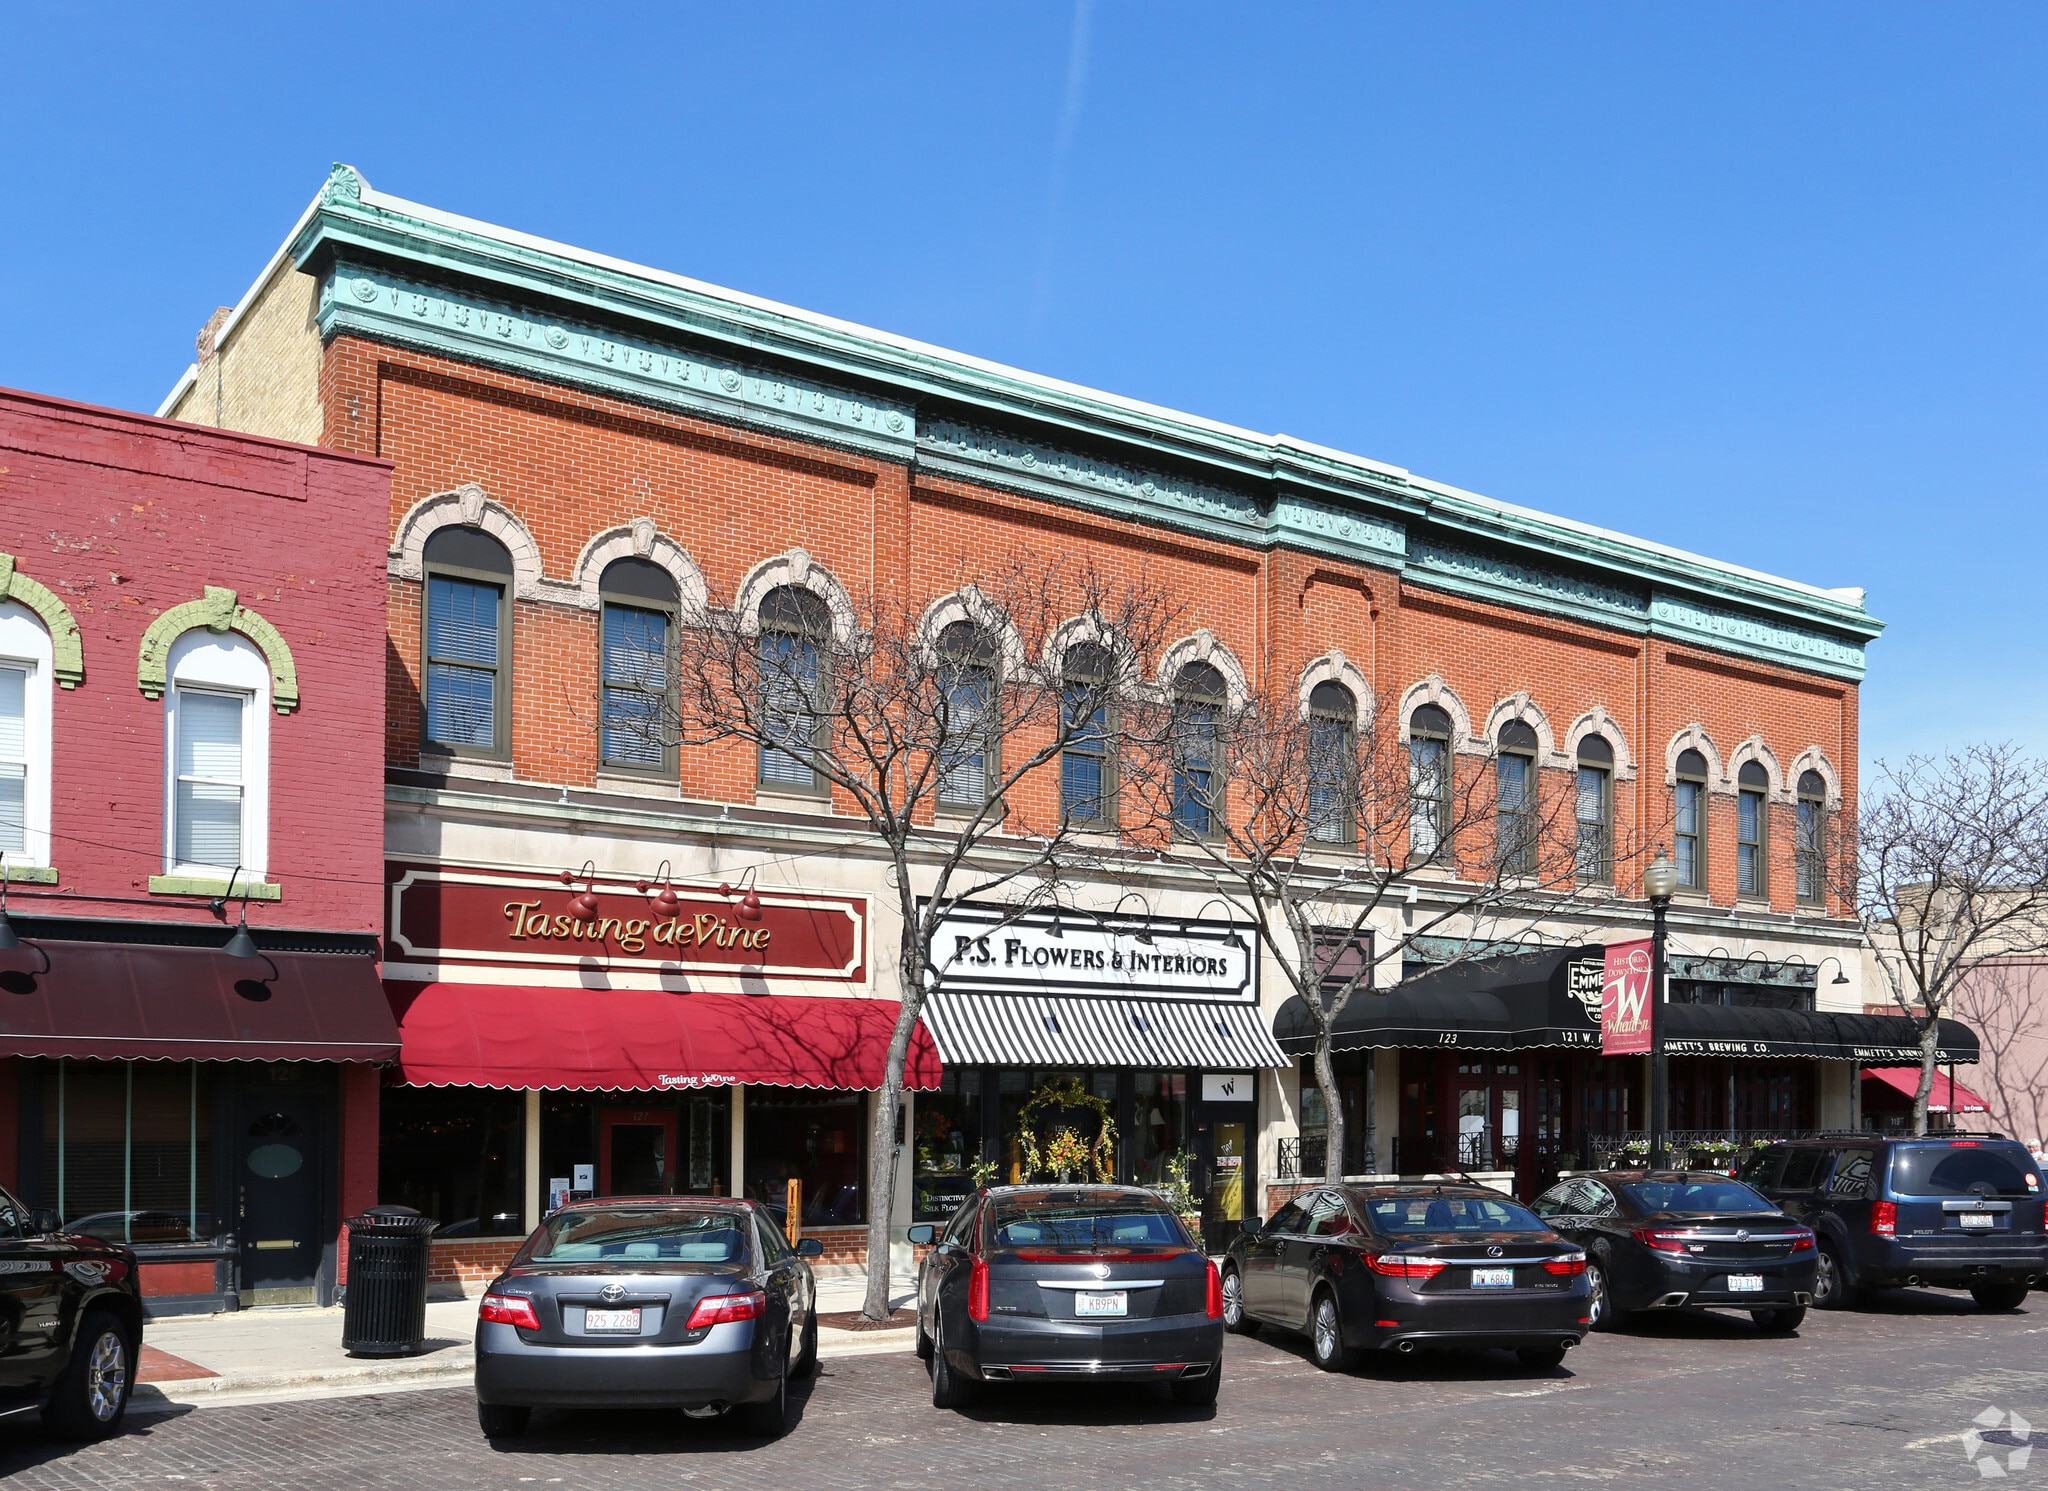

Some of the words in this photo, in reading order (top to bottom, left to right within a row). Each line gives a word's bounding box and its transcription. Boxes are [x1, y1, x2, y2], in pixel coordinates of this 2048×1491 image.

[504, 900, 650, 952] Tasting
[653, 912, 770, 949] deVine
[954, 935, 997, 963] P.S.
[1005, 938, 1104, 968] FLOWERS
[1112, 952, 1122, 969] &
[1130, 950, 1227, 975] INTERIORS
[1439, 1033, 1458, 1044] 123
[1562, 1032, 1578, 1042] 121
[1582, 1033, 1594, 1043] W.
[1708, 1042, 1747, 1052] BREWING
[1754, 1043, 1771, 1053] CO.
[1854, 1048, 1894, 1057] EMMETT'S
[1935, 1050, 1951, 1058] CO.
[658, 1074, 699, 1086] Tasting
[924, 1204, 939, 1212] SILK
[1490, 1274, 1510, 1285] 6869
[1089, 1298, 1119, 1311] KB9PN
[587, 1314, 607, 1328] 925
[612, 1314, 639, 1328] 2288
